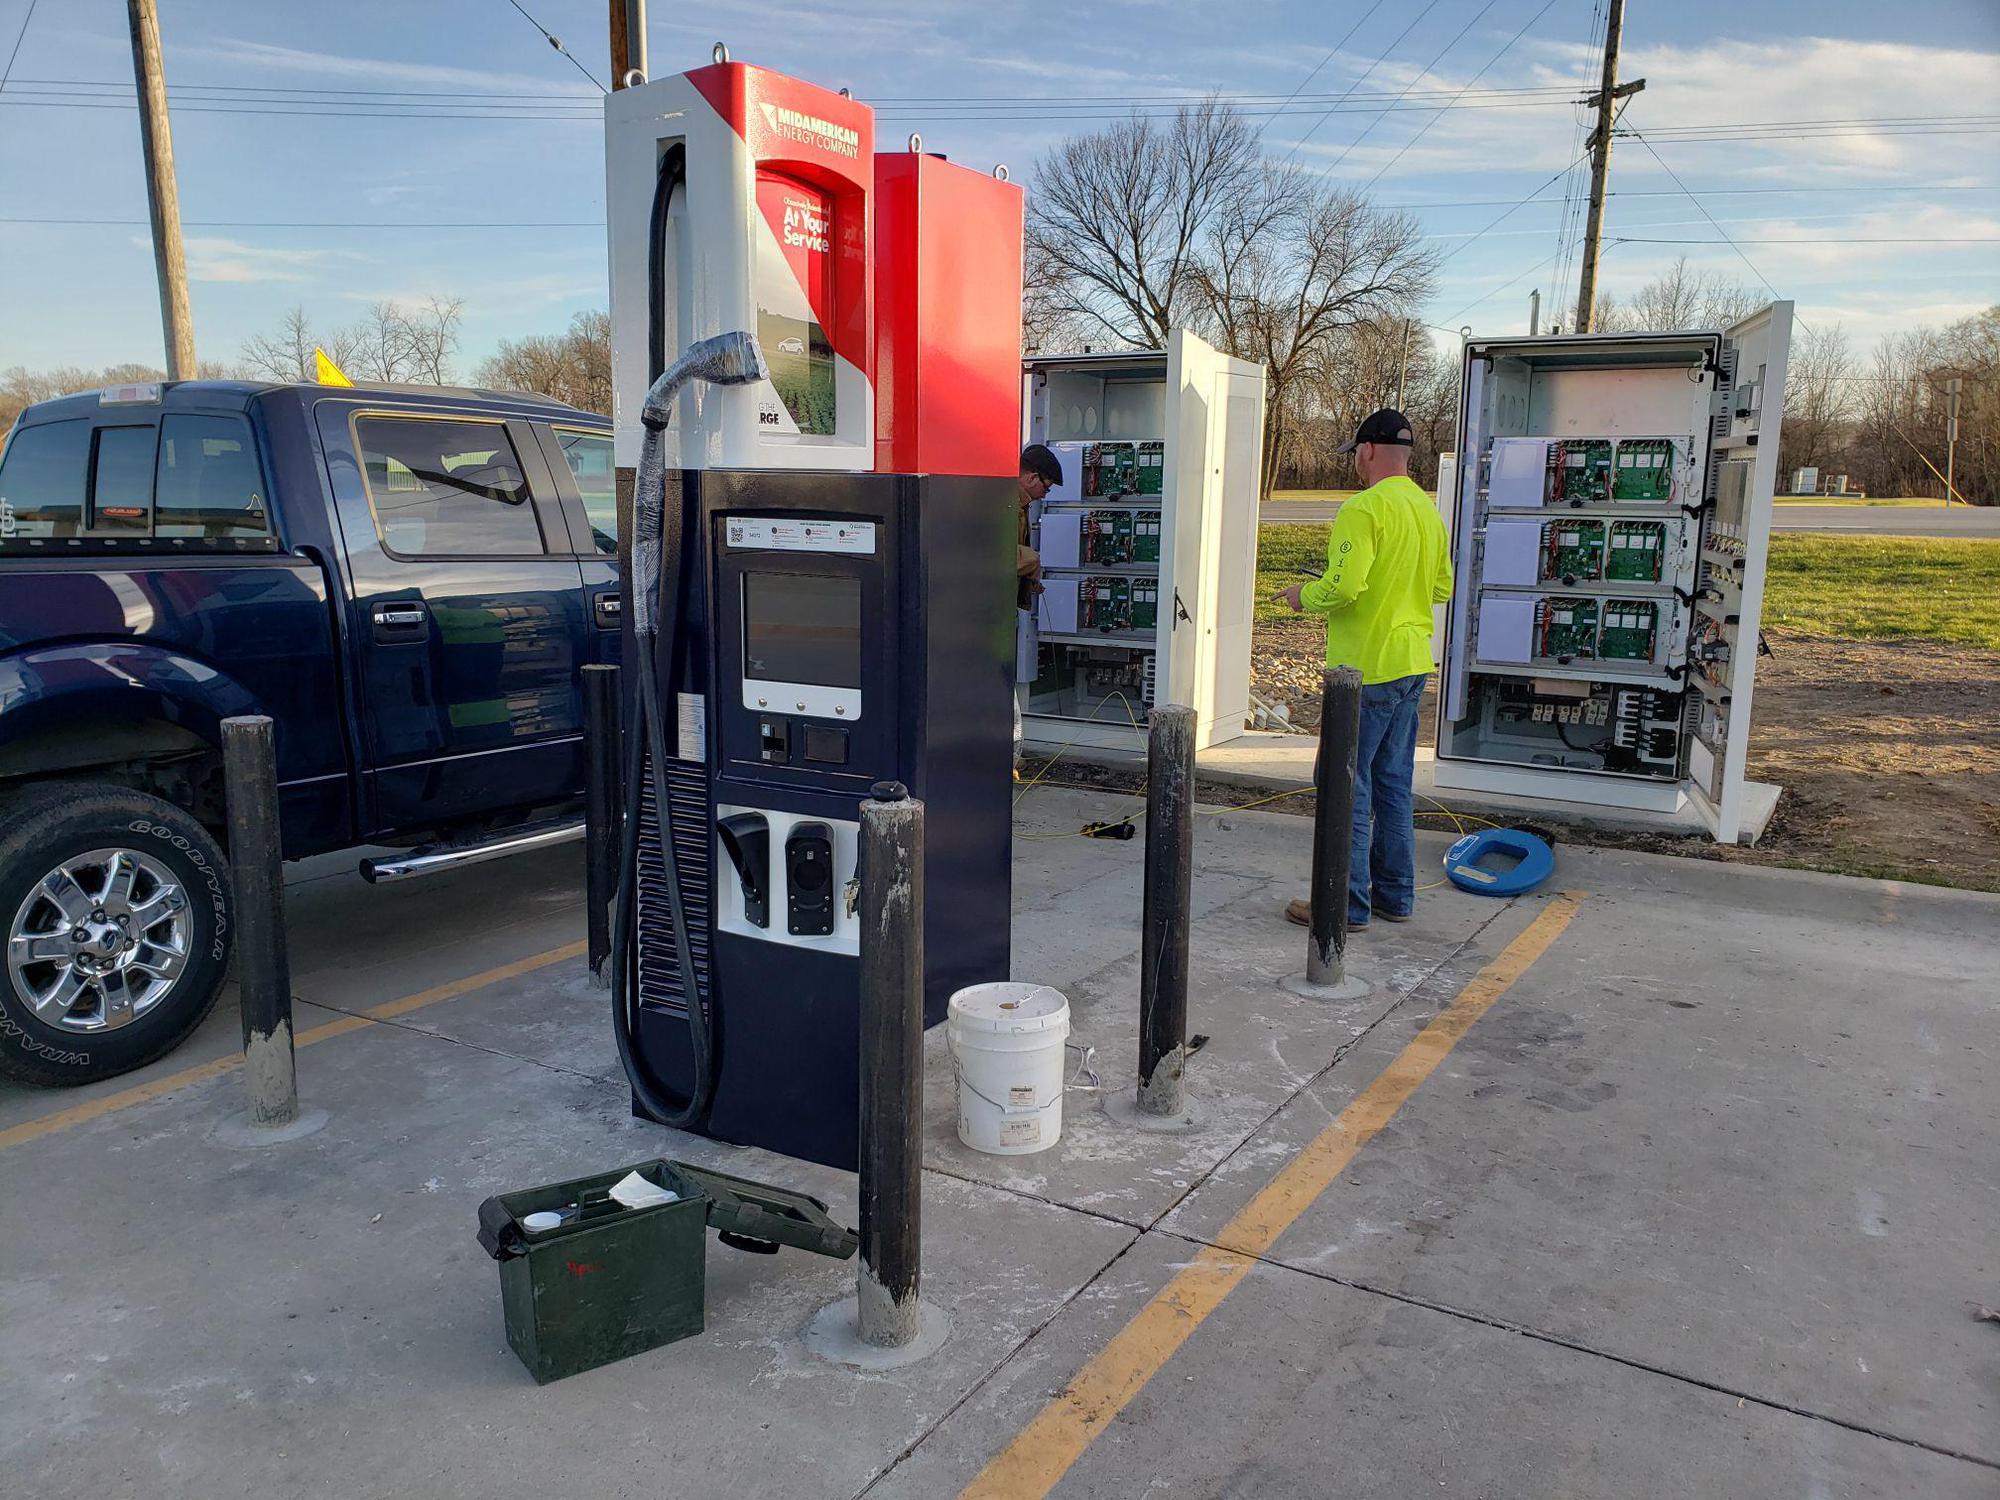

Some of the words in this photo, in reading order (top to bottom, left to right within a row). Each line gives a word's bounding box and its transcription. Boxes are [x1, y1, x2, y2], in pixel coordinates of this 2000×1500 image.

[777, 107, 859, 147] MIDAMERICAN
[778, 122, 815, 146] ENERGY
[816, 135, 859, 159] COMPANY
[783, 206, 799, 228] At
[801, 209, 829, 234] Your
[783, 224, 830, 253] Service
[759, 412, 780, 425] RGE
[129, 820, 226, 960] GOODYEAR
